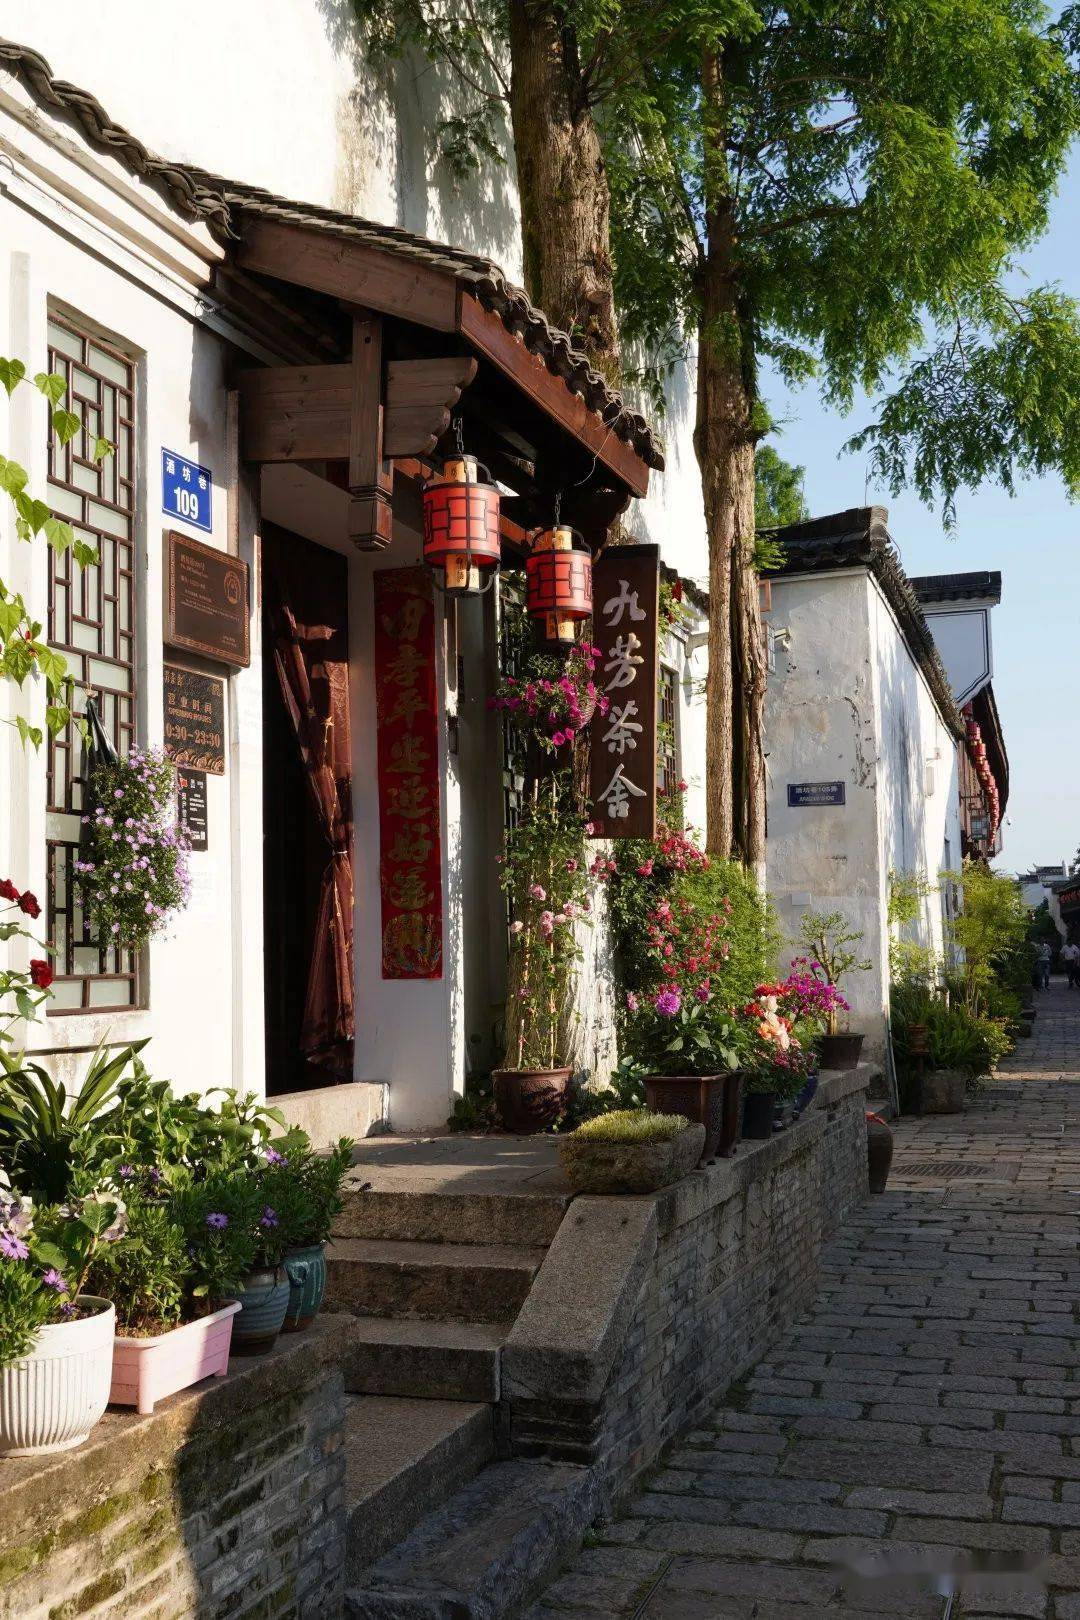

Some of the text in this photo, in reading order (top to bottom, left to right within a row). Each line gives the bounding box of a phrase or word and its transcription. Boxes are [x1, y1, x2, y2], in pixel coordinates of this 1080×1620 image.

[173, 486, 199, 520] 109
[597, 579, 647, 818] 九芳茶舍
